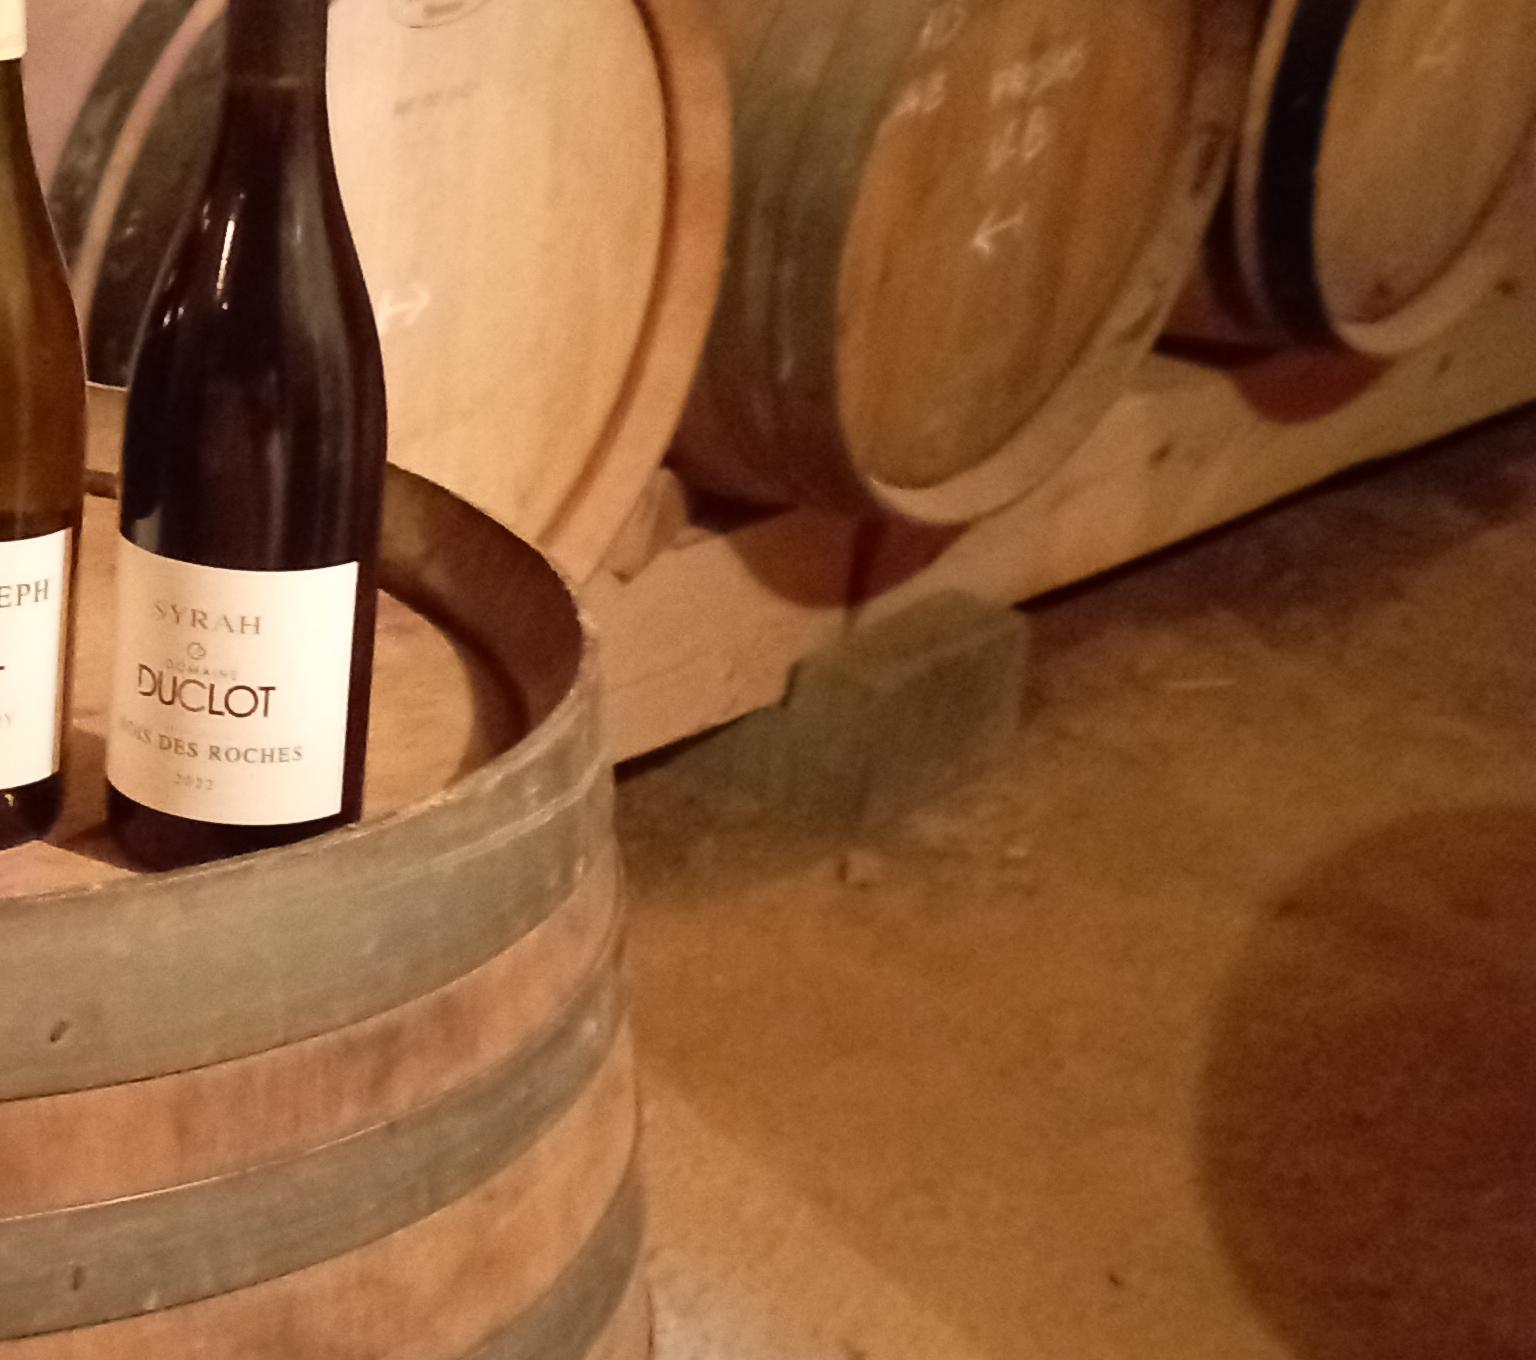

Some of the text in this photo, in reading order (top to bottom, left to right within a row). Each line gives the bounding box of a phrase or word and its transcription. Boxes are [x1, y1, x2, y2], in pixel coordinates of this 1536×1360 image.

[154, 601, 261, 635] SYRAH
[138, 663, 276, 718] DUCLOT
[158, 733, 199, 758] DES
[207, 745, 304, 765] ROCHES
